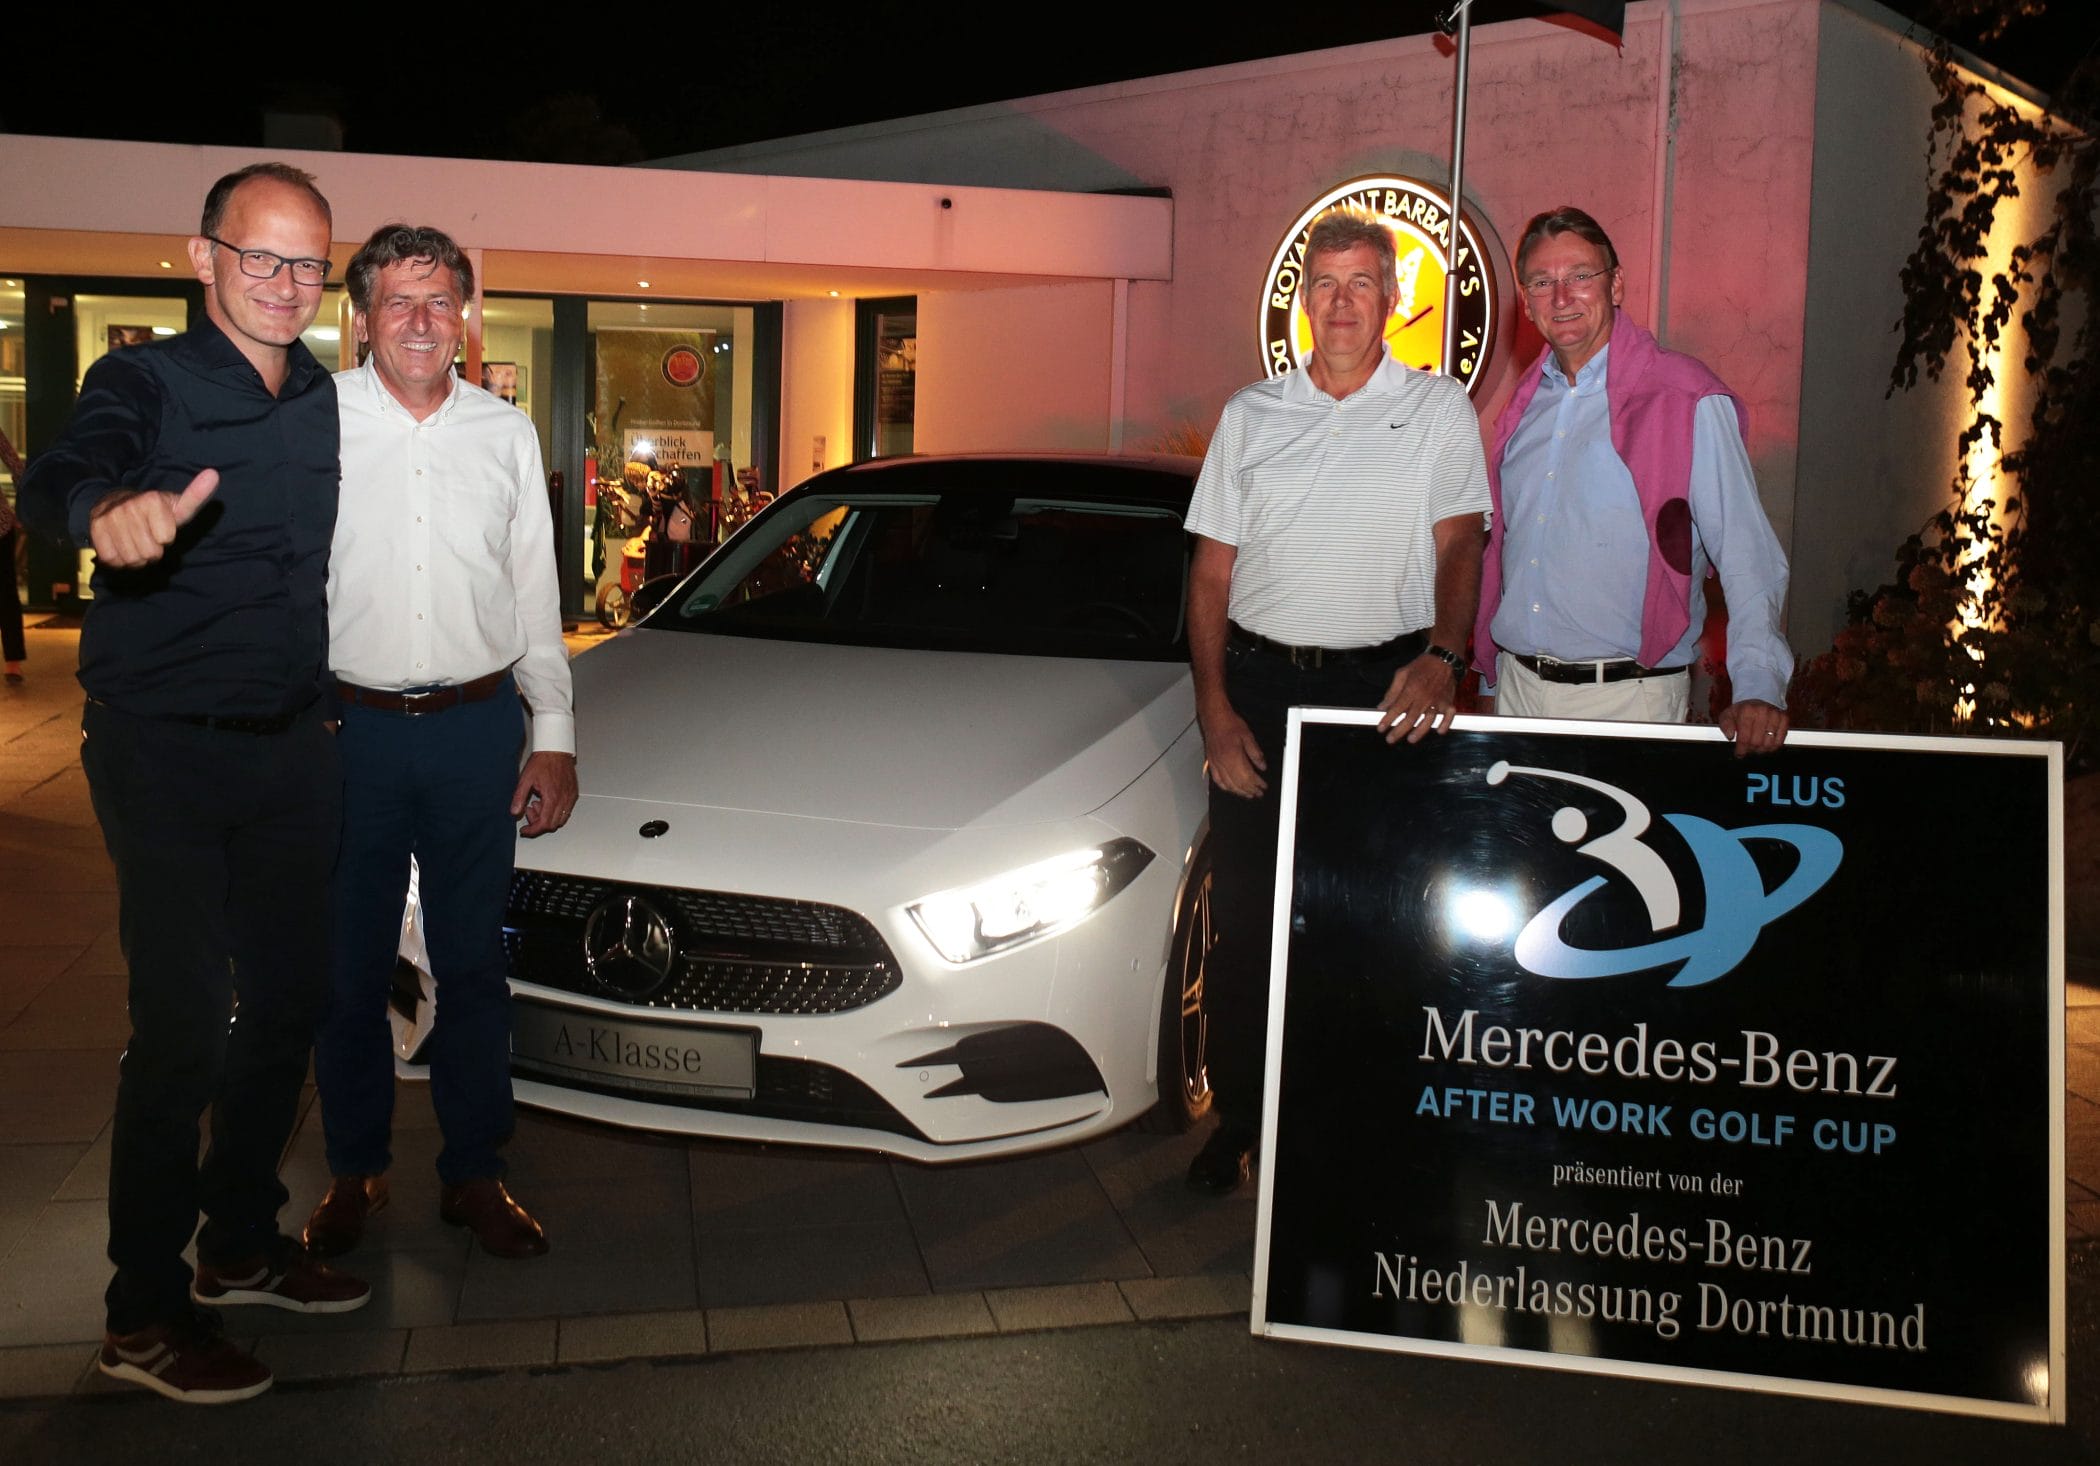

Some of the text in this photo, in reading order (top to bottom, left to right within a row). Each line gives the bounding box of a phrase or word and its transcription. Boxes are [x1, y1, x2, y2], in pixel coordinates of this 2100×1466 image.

[1746, 772, 1845, 808] PLUS
[554, 1024, 701, 1073] A-Klasse
[1418, 1005, 1898, 1098] Mercedes-Benz
[1415, 1086, 1897, 1155] AFTER WORK GOLF CUP
[1553, 1161, 1744, 1196] präsentiert von der
[1481, 1199, 1813, 1274] Mercedes-Benz
[1372, 1251, 1927, 1351] Niederlassung Dortmund
